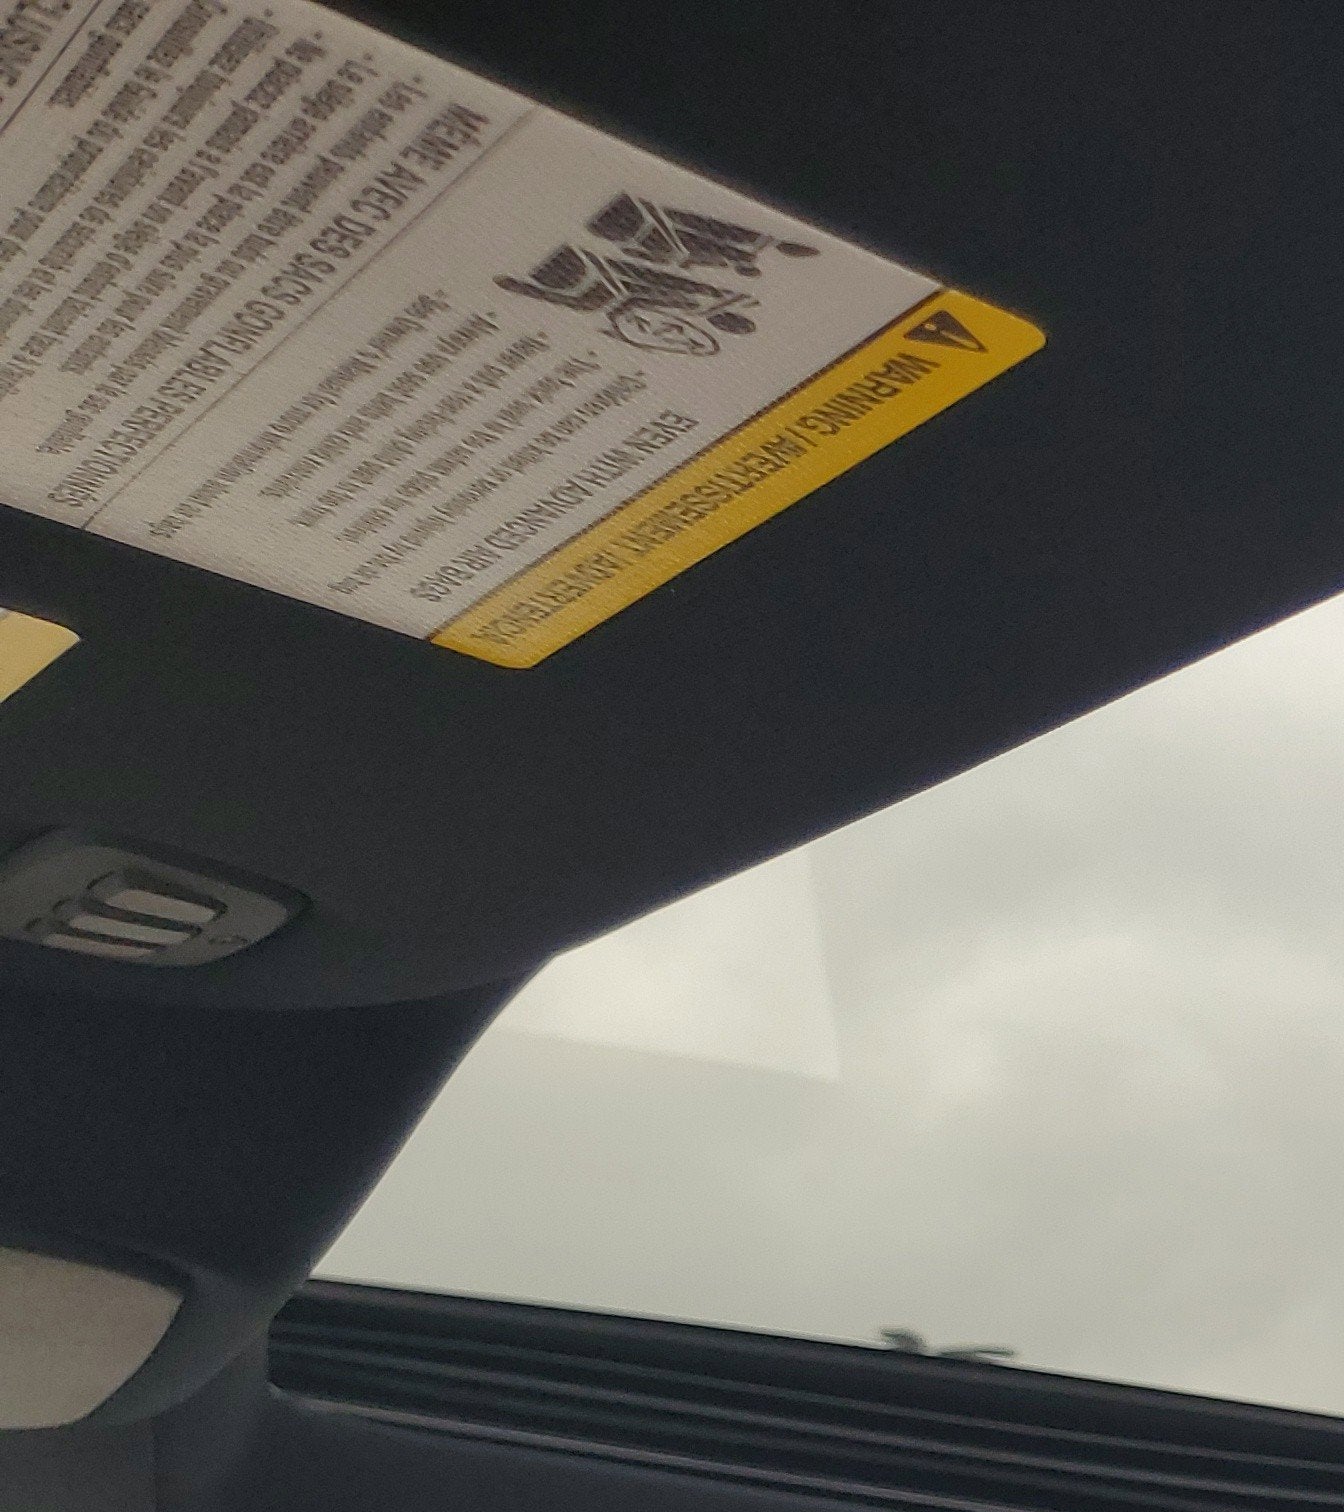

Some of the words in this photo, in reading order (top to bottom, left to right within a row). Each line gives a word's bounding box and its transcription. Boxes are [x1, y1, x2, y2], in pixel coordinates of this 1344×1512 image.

[335, 59, 379, 85] Le
[349, 161, 426, 221] AVEC
[308, 213, 377, 259] DES
[260, 252, 337, 306] SACS
[156, 299, 286, 404] GONFLABLES
[554, 356, 602, 380] The
[106, 363, 139, 388] par
[794, 352, 940, 436] WARNING
[549, 413, 588, 436] can
[622, 410, 699, 455] EVEN
[46, 397, 185, 508] PERFECTIONNÉS
[573, 448, 646, 488] WITH
[483, 479, 594, 551] ADVANCED
[610, 433, 808, 558] AVERTISSEMENT
[450, 544, 503, 571] AIR
[409, 565, 476, 603] BAGS
